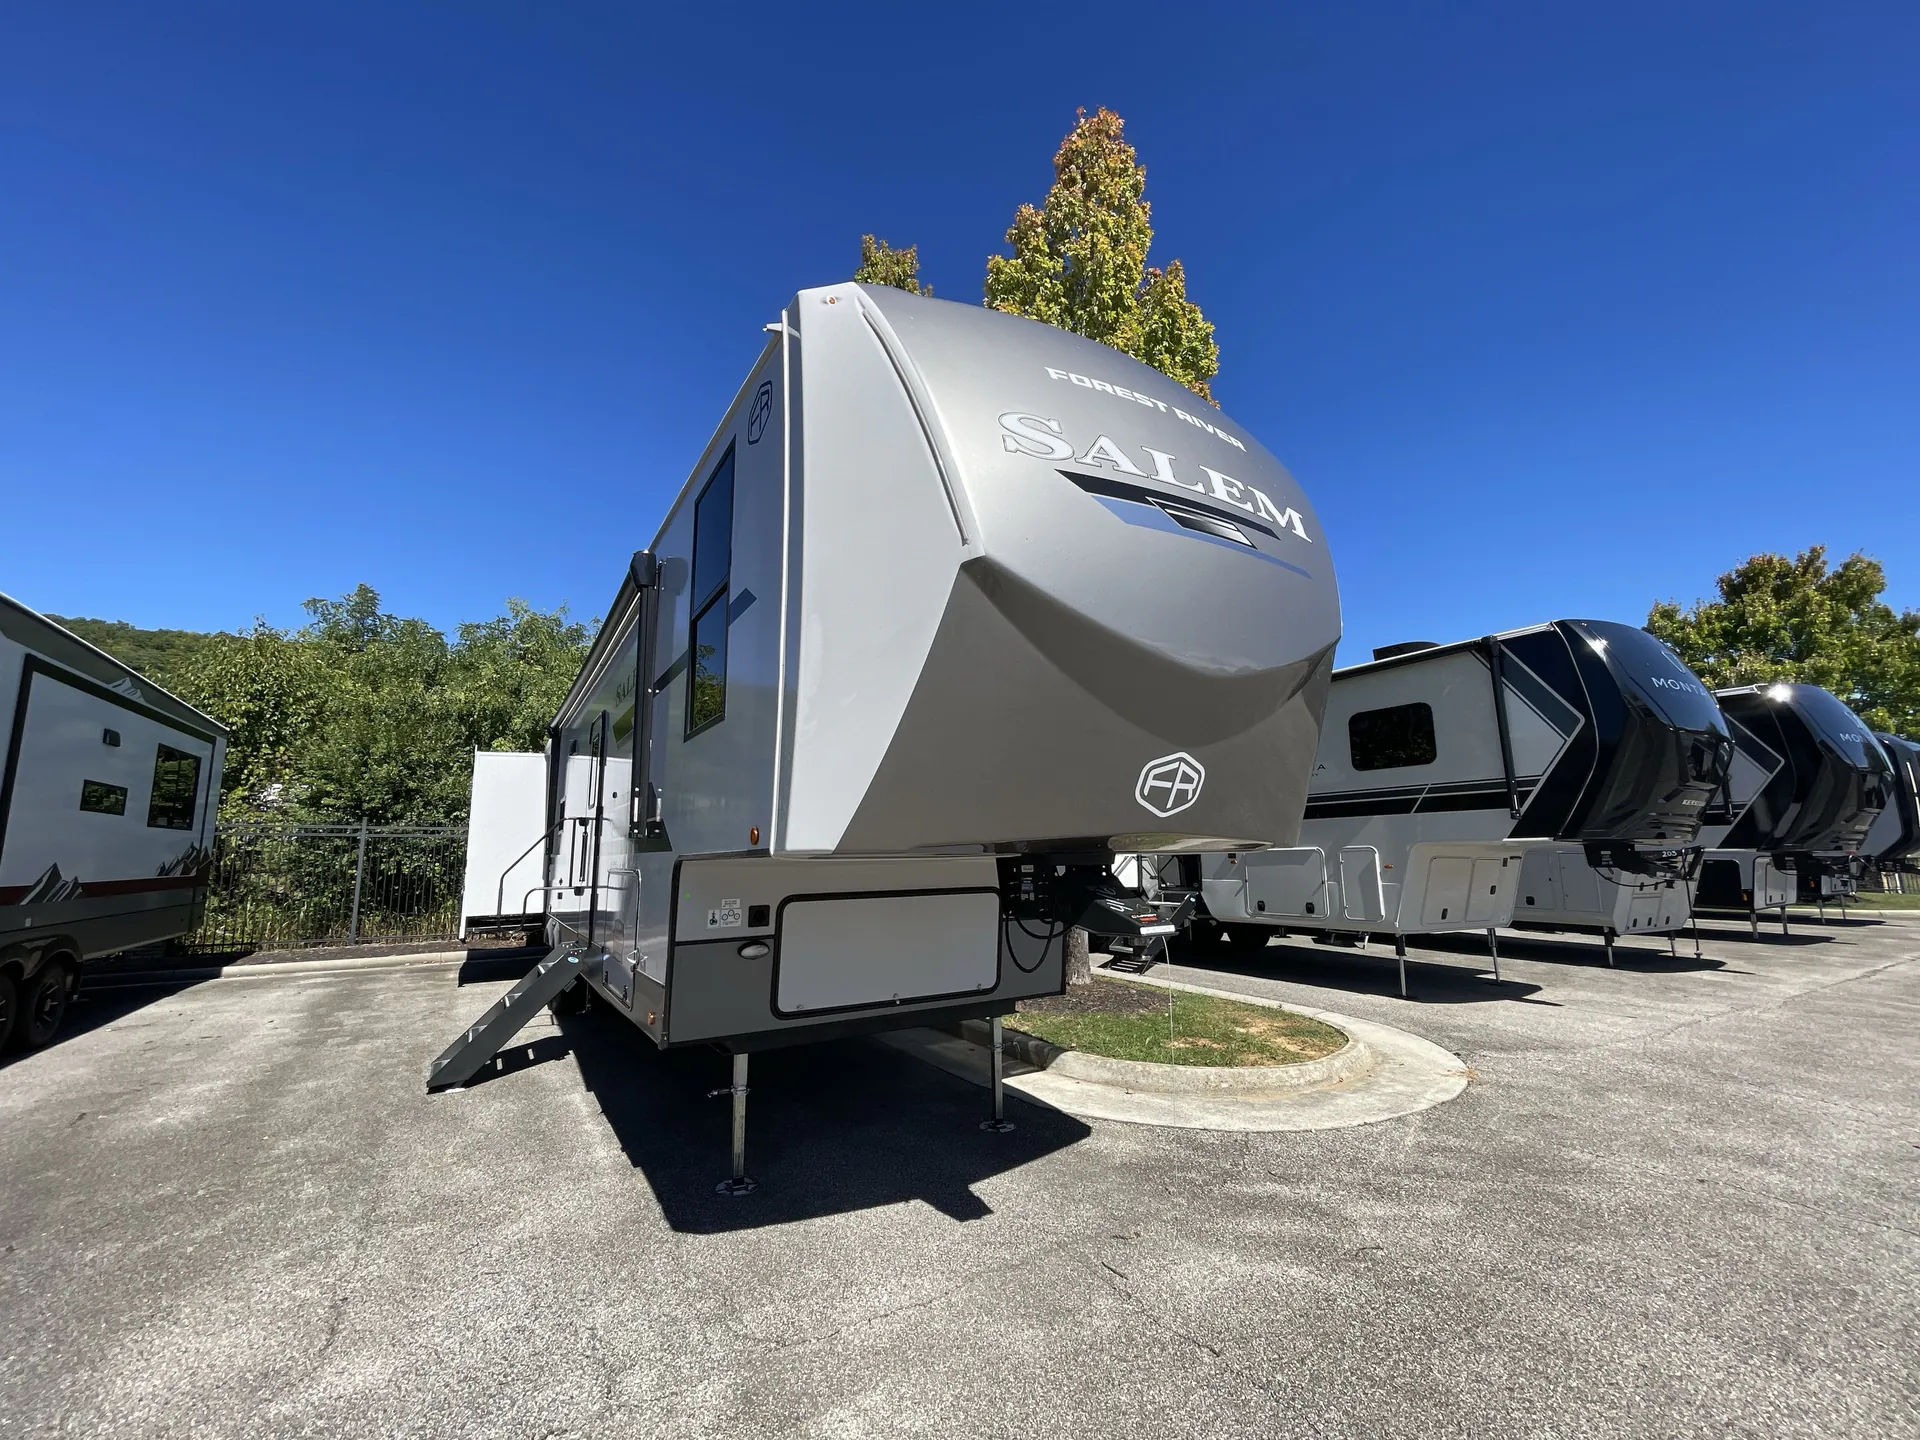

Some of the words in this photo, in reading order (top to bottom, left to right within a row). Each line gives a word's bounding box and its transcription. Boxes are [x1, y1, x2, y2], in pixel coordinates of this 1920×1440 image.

[1044, 366, 1168, 413] FOREST
[1172, 406, 1247, 453] RIVER
[998, 411, 1312, 543] SALEM
